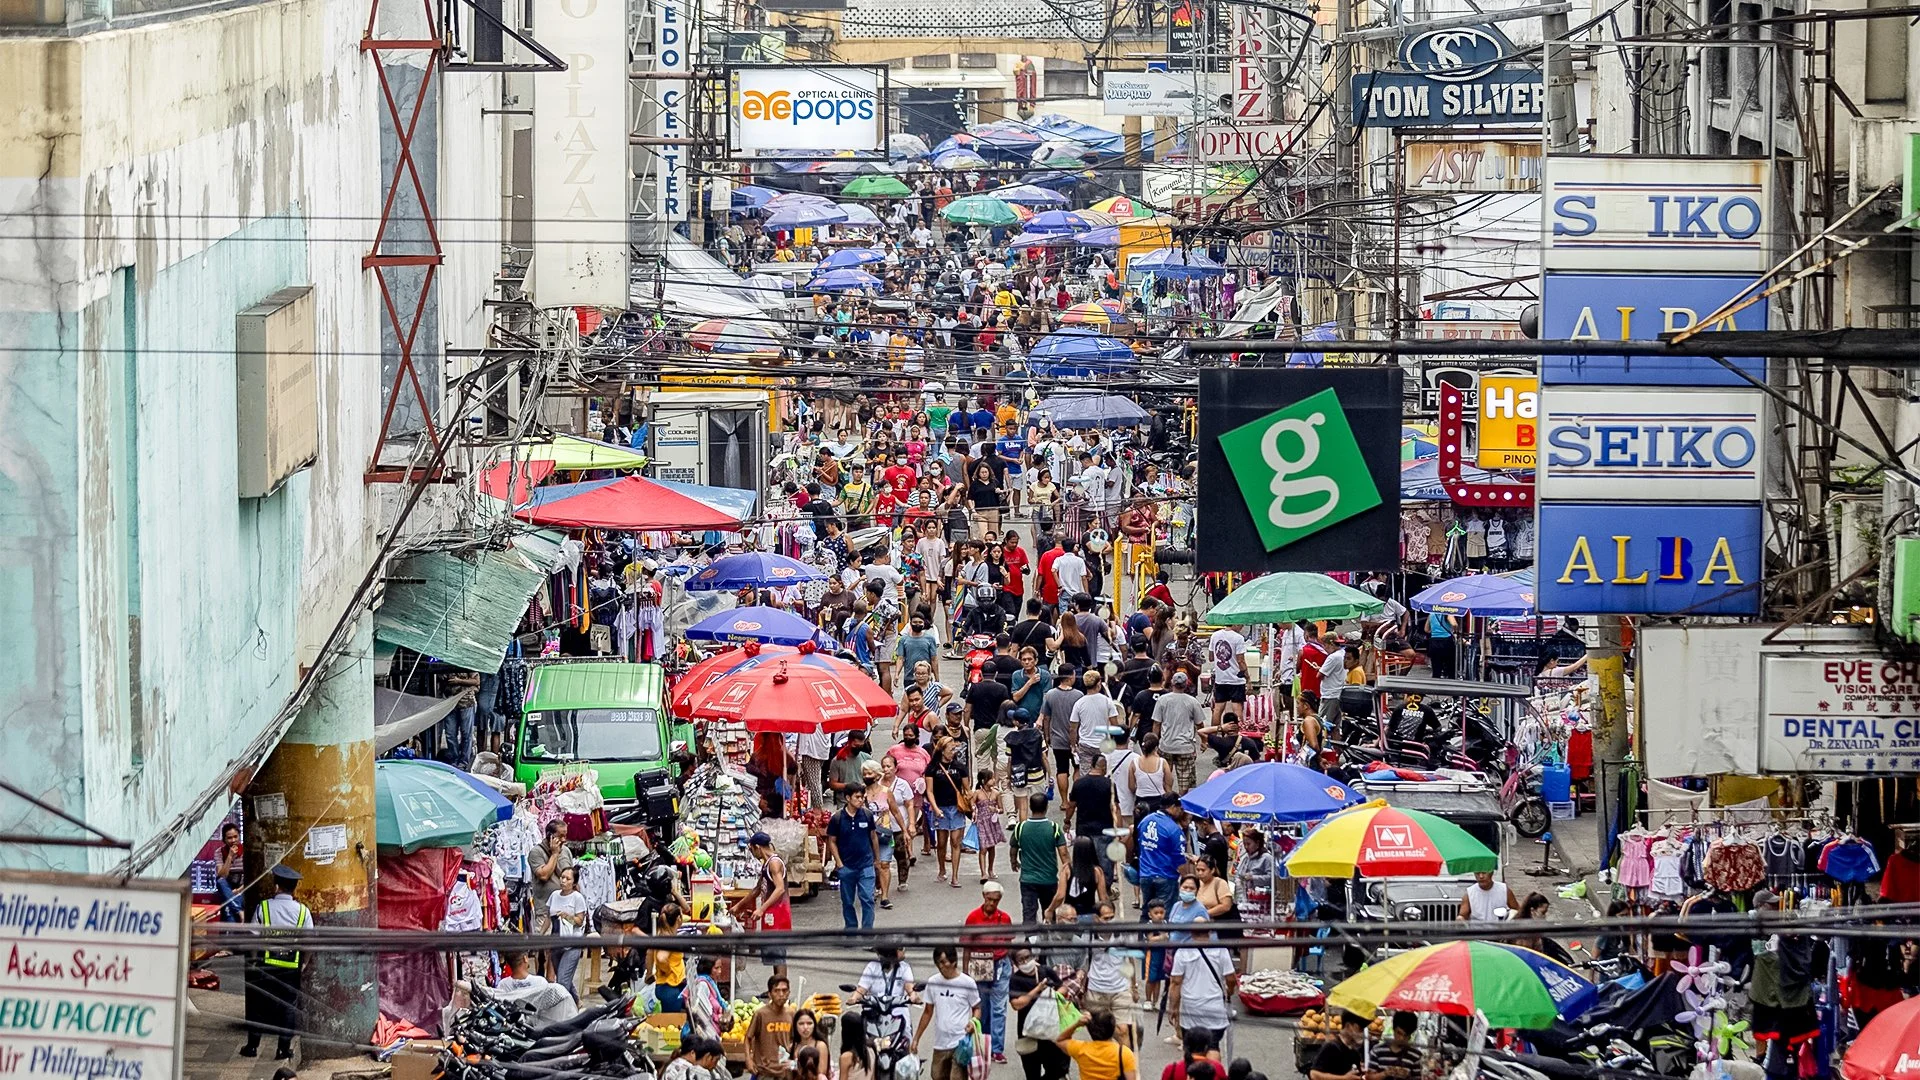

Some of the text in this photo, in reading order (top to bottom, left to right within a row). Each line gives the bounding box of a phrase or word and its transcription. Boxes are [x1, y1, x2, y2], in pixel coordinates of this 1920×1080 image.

[798, 90, 873, 99] OPTICAL CLINIC
[1362, 86, 1430, 118] TOM
[562, 53, 599, 218] PLAZA
[663, 90, 679, 215] CENTER
[1548, 425, 1757, 468] SEIKO
[1261, 412, 1340, 530] g
[1556, 535, 1744, 584] ALBA
[1823, 662, 1872, 683] EYE
[1834, 684, 1913, 694] VISION CARE
[1784, 718, 1884, 739] DENTAL
[1827, 739, 1880, 750] ZENAIDA
[85, 899, 163, 936] Airlines
[7, 942, 133, 988] Asian Spirit
